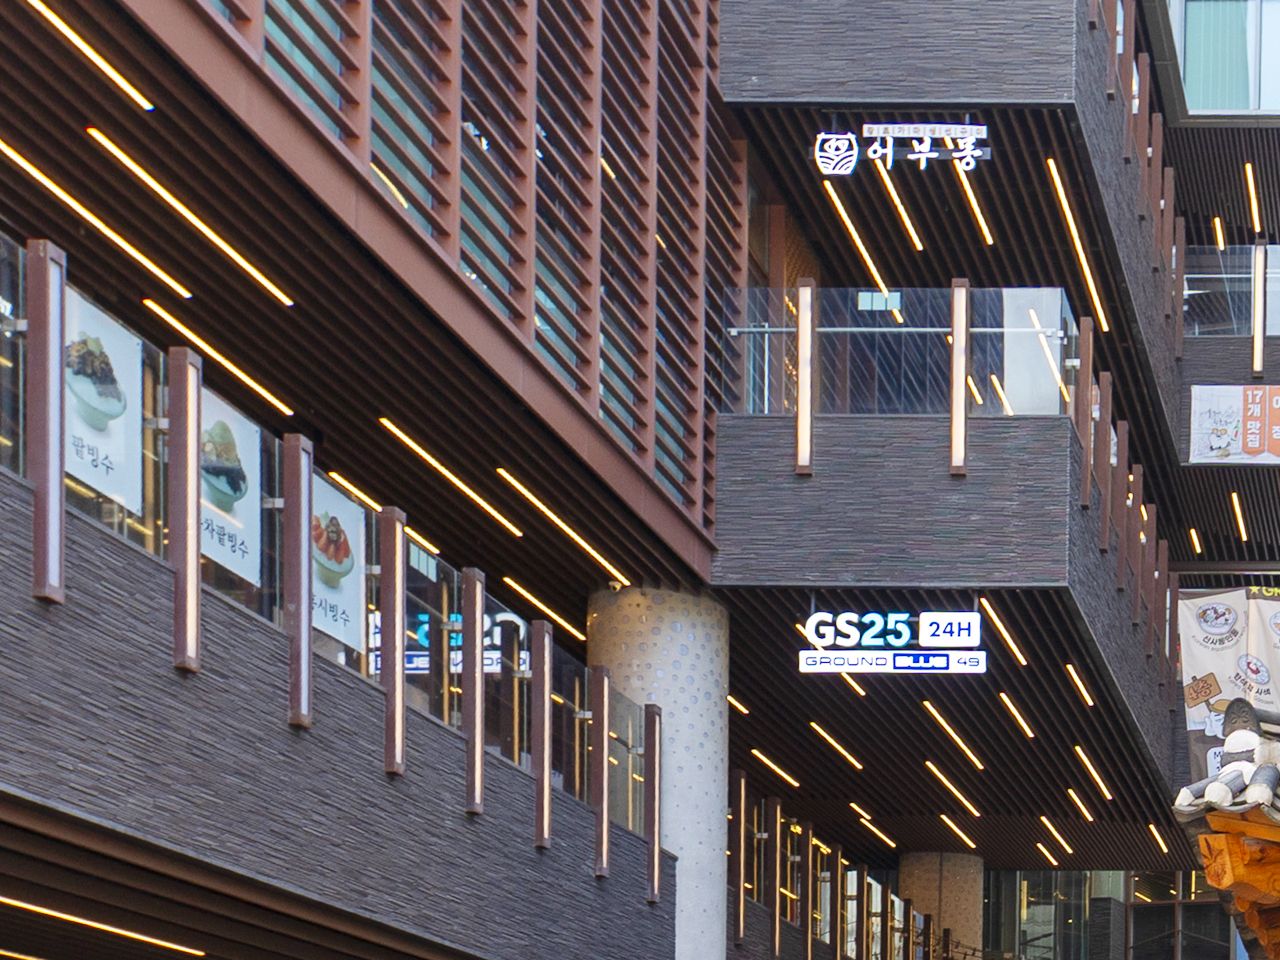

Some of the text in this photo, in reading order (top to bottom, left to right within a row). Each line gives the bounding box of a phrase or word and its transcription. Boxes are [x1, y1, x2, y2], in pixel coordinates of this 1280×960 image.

[200, 518, 249, 559] 차팥빙수
[805, 612, 972, 647] GS25 24H
[805, 656, 888, 666] GROUND
[957, 657, 980, 666] 49
